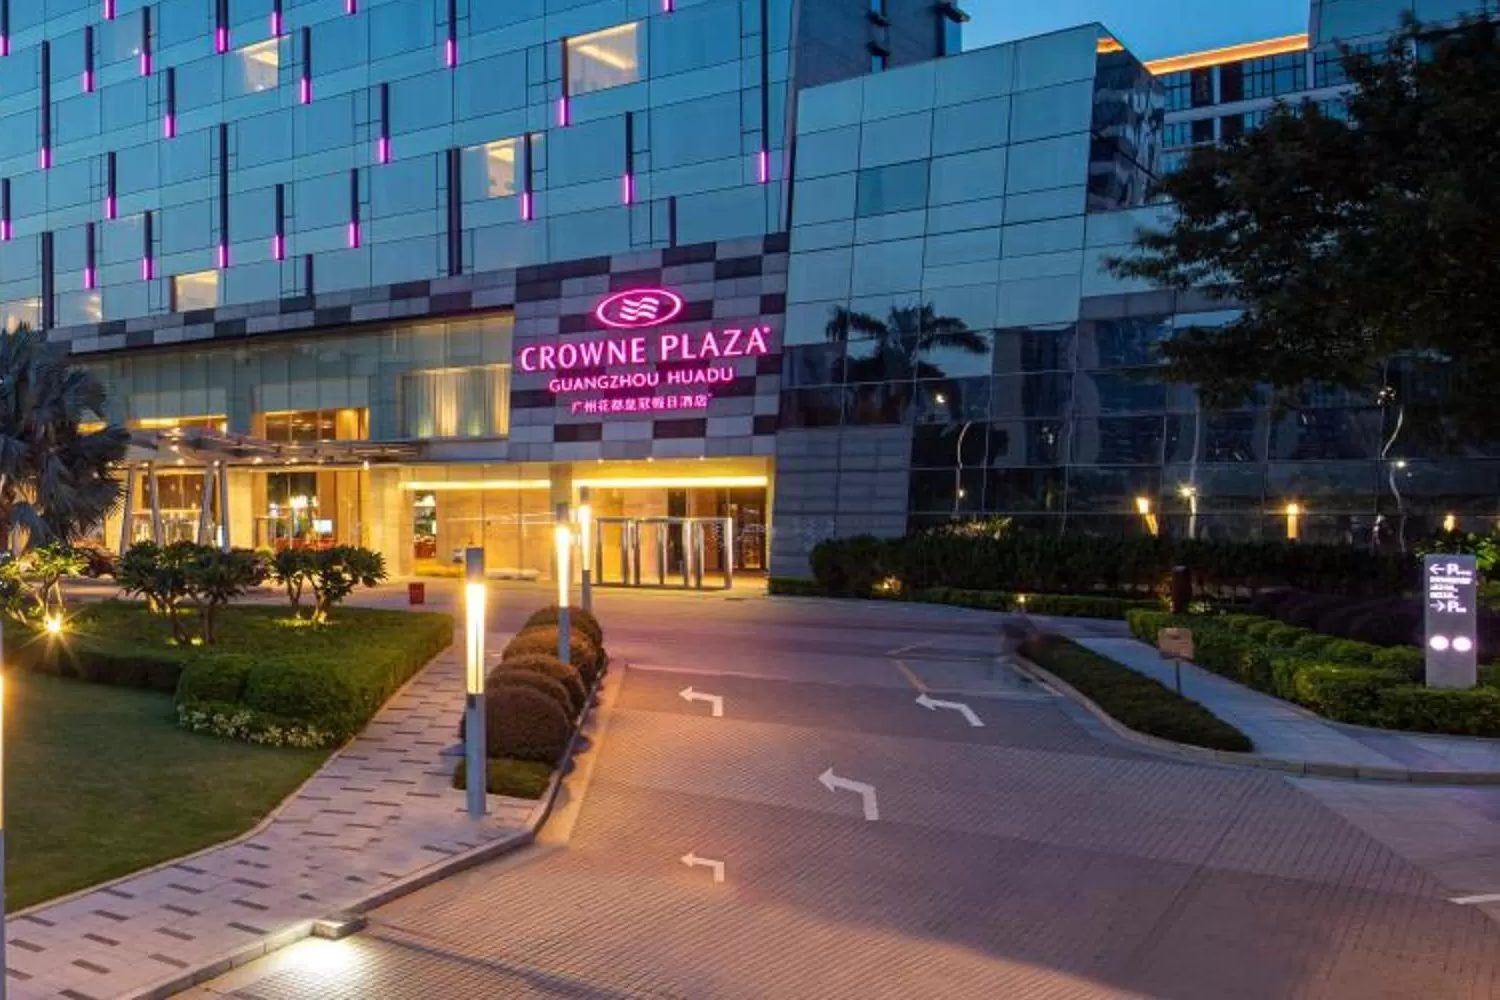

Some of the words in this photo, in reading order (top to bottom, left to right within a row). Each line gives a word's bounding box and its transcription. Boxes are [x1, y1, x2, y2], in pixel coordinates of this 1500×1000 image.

[520, 337, 646, 372] CROWNE
[660, 327, 768, 361] PLAZA
[549, 371, 660, 392] GUANGZHOU
[667, 367, 734, 385] HUADU
